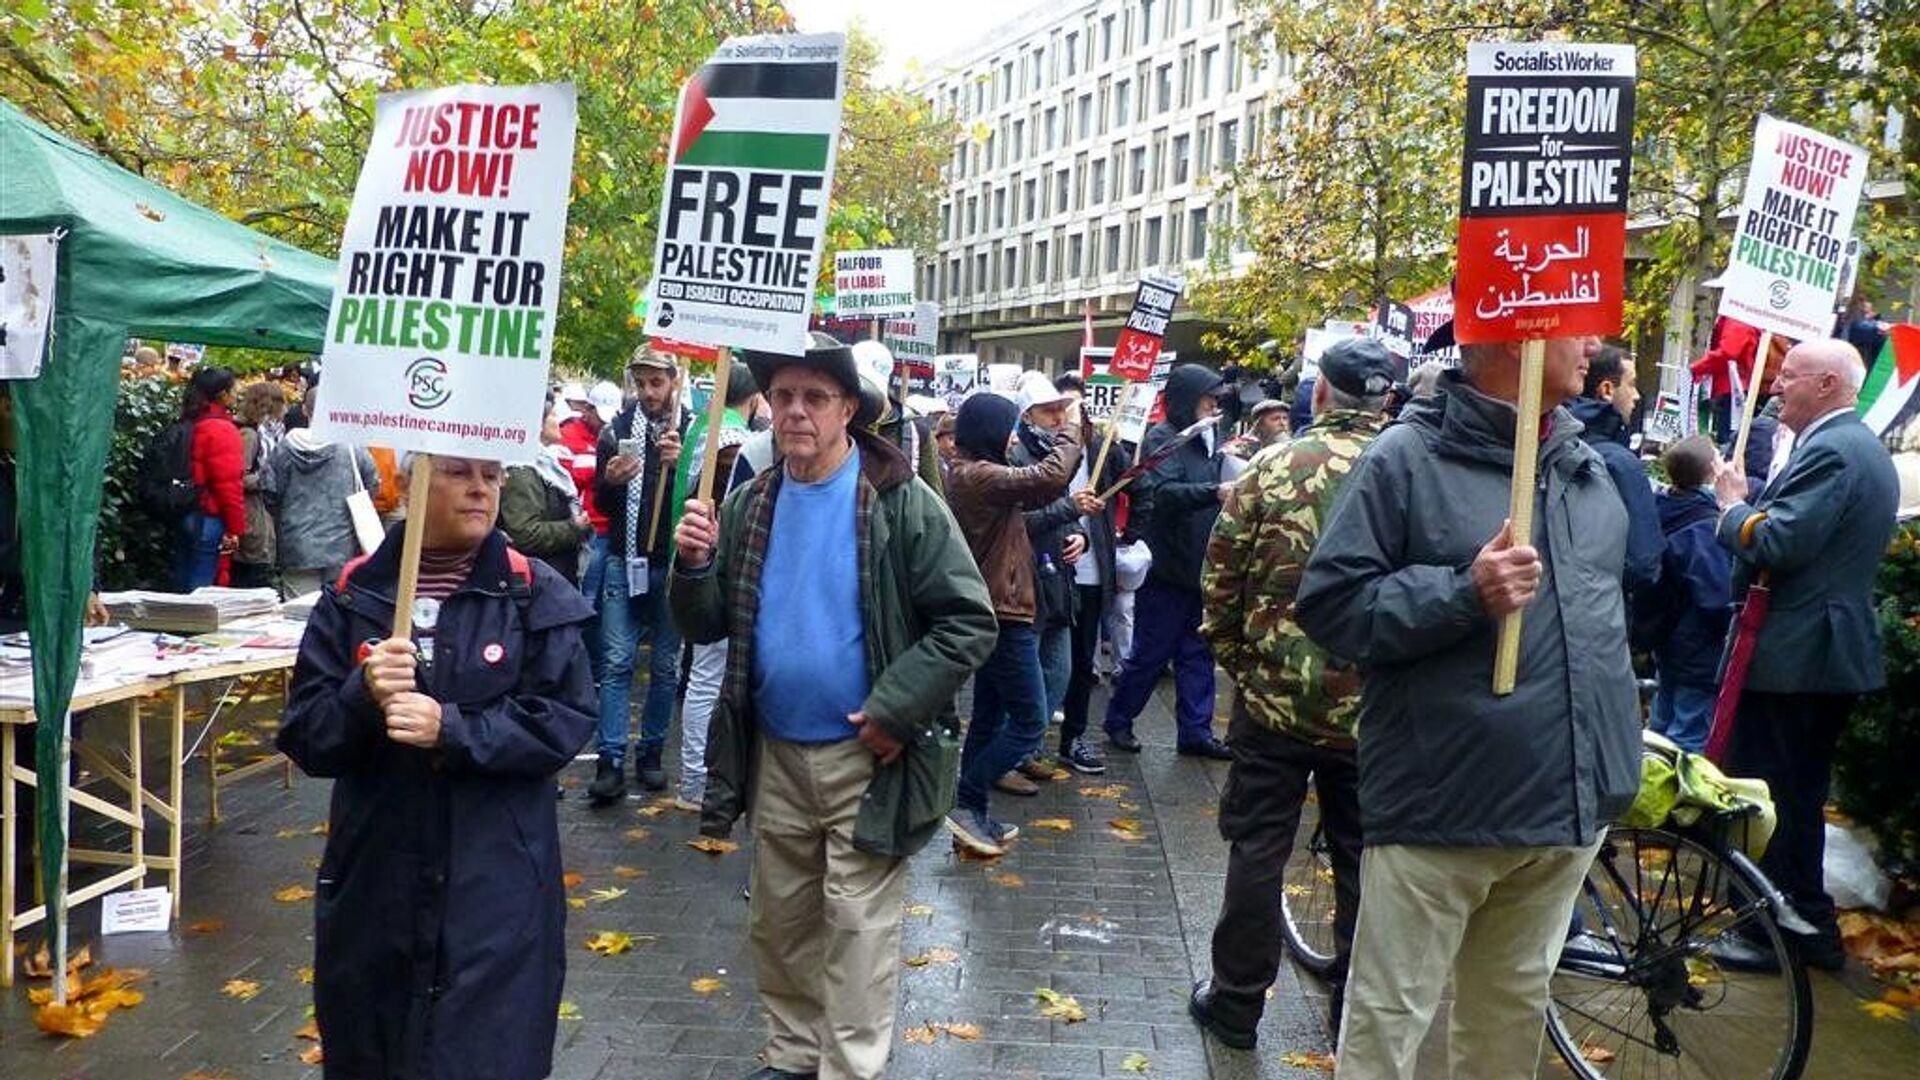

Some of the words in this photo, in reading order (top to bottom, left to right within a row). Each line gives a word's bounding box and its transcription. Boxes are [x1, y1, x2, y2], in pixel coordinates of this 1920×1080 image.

[1494, 51, 1564, 72] Socialist
[1564, 51, 1615, 72] Worker
[395, 103, 541, 150] JUSTICE
[1481, 87, 1620, 135] FREEDOM
[1540, 135, 1564, 157] for
[1775, 130, 1852, 179] JUSTICE
[403, 150, 513, 198] NOW!
[1470, 159, 1621, 208] PALESTINE
[1780, 160, 1835, 200] NOW!
[374, 205, 481, 254] MAKE
[490, 211, 530, 257] IT
[665, 169, 824, 250] FREE
[1762, 187, 1815, 229] MAKE
[1818, 207, 1839, 236] IT
[1494, 225, 1590, 273] الحرية
[1744, 209, 1806, 251] RIGHT
[1806, 230, 1841, 265] FOR
[347, 252, 466, 301] RIGHT
[471, 258, 546, 307] FOR
[659, 242, 812, 289] PALESTINE
[838, 257, 882, 272] BALFOUR
[851, 275, 886, 290] LIABLE
[1736, 234, 1837, 293] PALESTINE
[660, 282, 684, 297] END
[685, 284, 727, 303] ISRAELI
[729, 290, 804, 311] OCCUPATION
[838, 294, 860, 310] FREE
[861, 292, 912, 308] PALESTINE
[1475, 269, 1600, 319] لفلسطين
[334, 298, 546, 360] PALESTINE
[894, 339, 936, 356] PALESTINE
[410, 372, 444, 394] PSC
[329, 410, 526, 444] www.palestinecampaign.org
